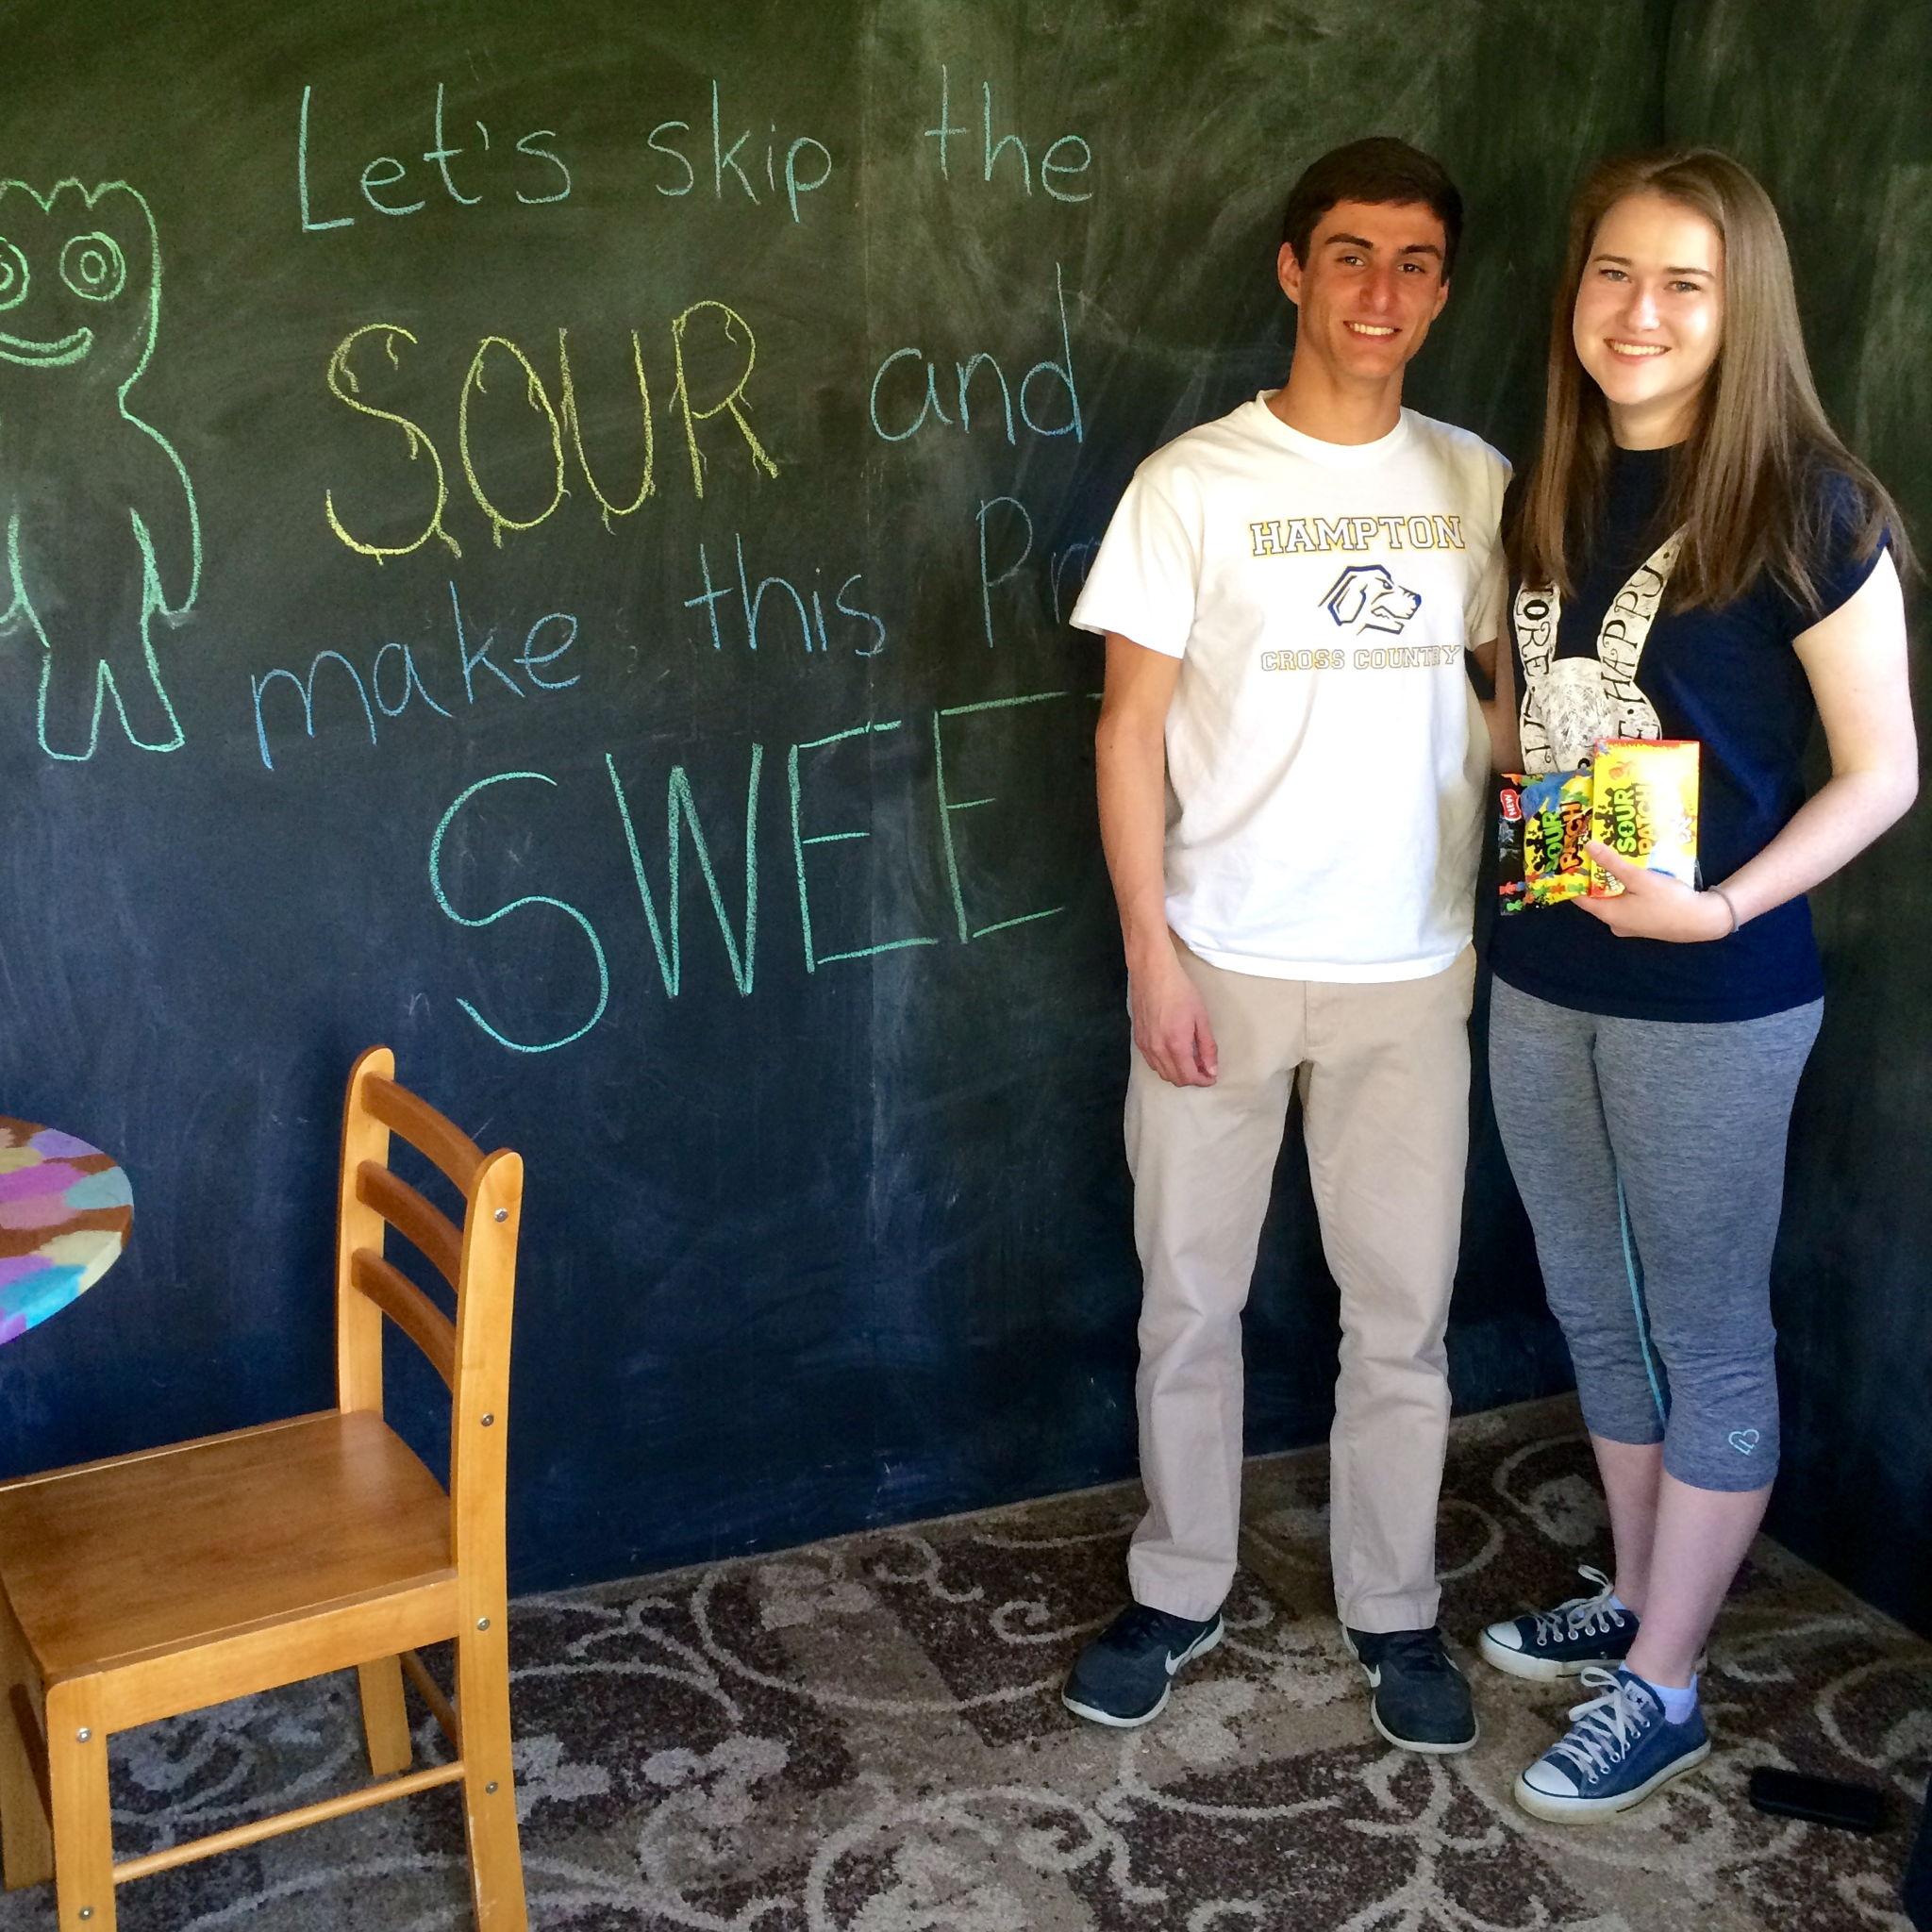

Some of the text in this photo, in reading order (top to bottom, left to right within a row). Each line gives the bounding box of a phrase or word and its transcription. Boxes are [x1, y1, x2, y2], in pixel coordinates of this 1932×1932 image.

[299, 63, 1092, 232] Let's skip the
[325, 261, 1084, 566] SOUR and
[1250, 515, 1466, 557] HAMPTON
[251, 496, 1102, 770] make this Pr
[1260, 645, 1462, 672] CROSS COUNTRY
[1503, 794, 1517, 816] NEW
[1614, 788, 1637, 853] SOUR
[427, 691, 1103, 1053] SWEE
[1541, 811, 1564, 873] SOUR
